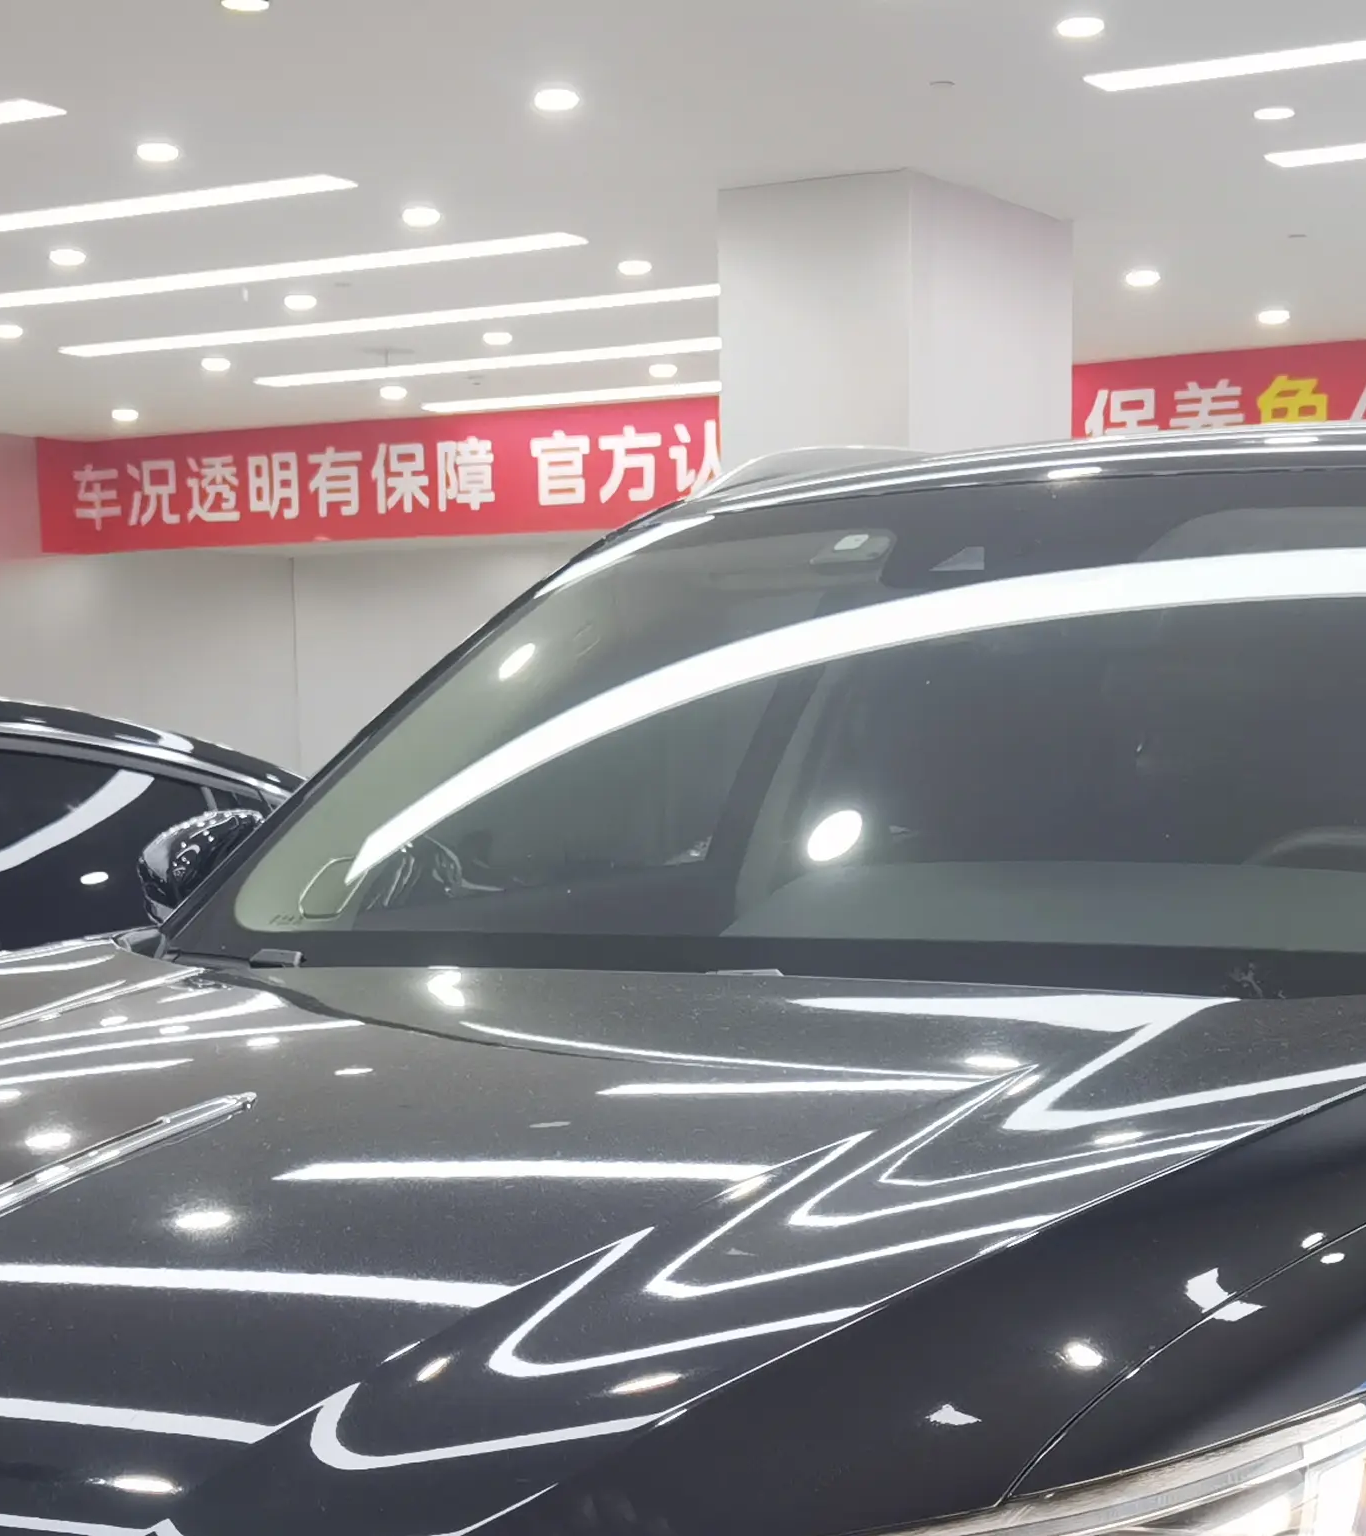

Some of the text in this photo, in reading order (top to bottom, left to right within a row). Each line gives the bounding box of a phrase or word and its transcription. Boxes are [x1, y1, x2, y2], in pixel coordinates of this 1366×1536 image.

[73, 419, 722, 530] 车况透明有保障 官方认
